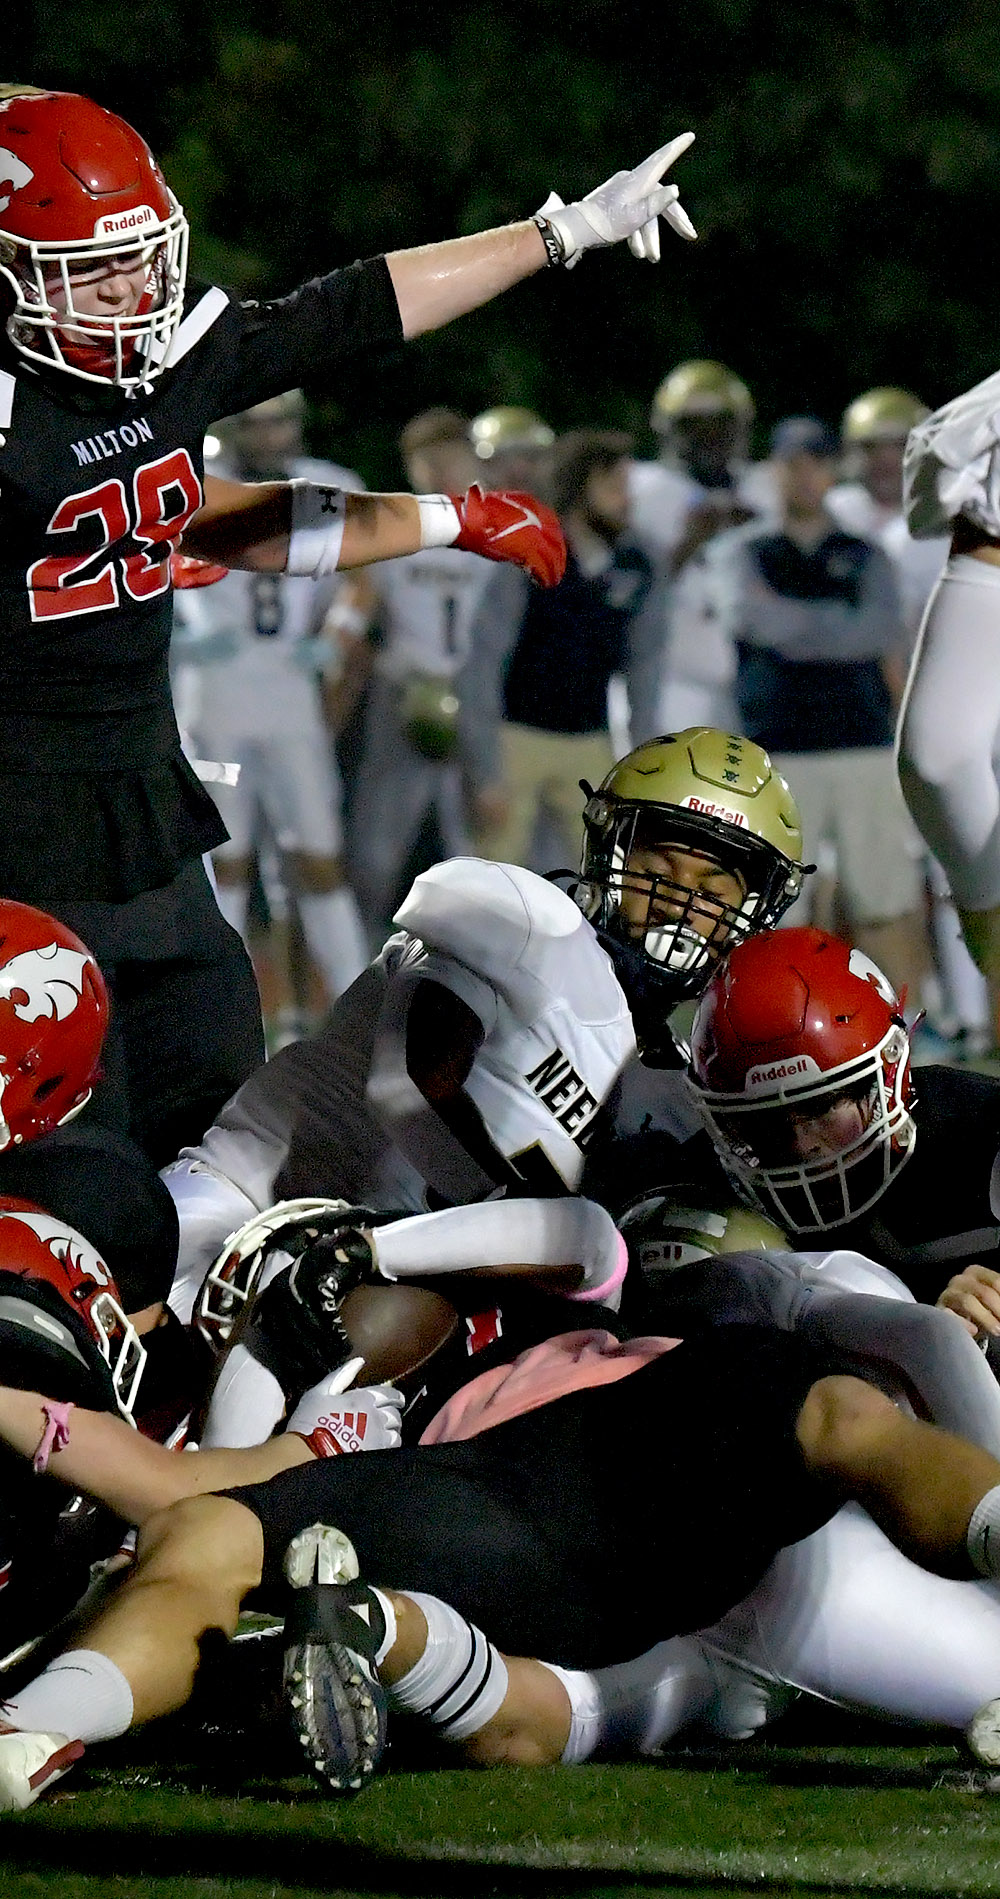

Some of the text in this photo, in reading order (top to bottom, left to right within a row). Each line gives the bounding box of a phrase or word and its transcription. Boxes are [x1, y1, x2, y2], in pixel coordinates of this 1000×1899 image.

[103, 209, 152, 233] Riddell
[70, 418, 154, 466] MILTON
[26, 447, 203, 623] 28
[688, 797, 744, 826] Riddell
[751, 1059, 808, 1084] Riddell
[317, 1415, 360, 1452] adida
